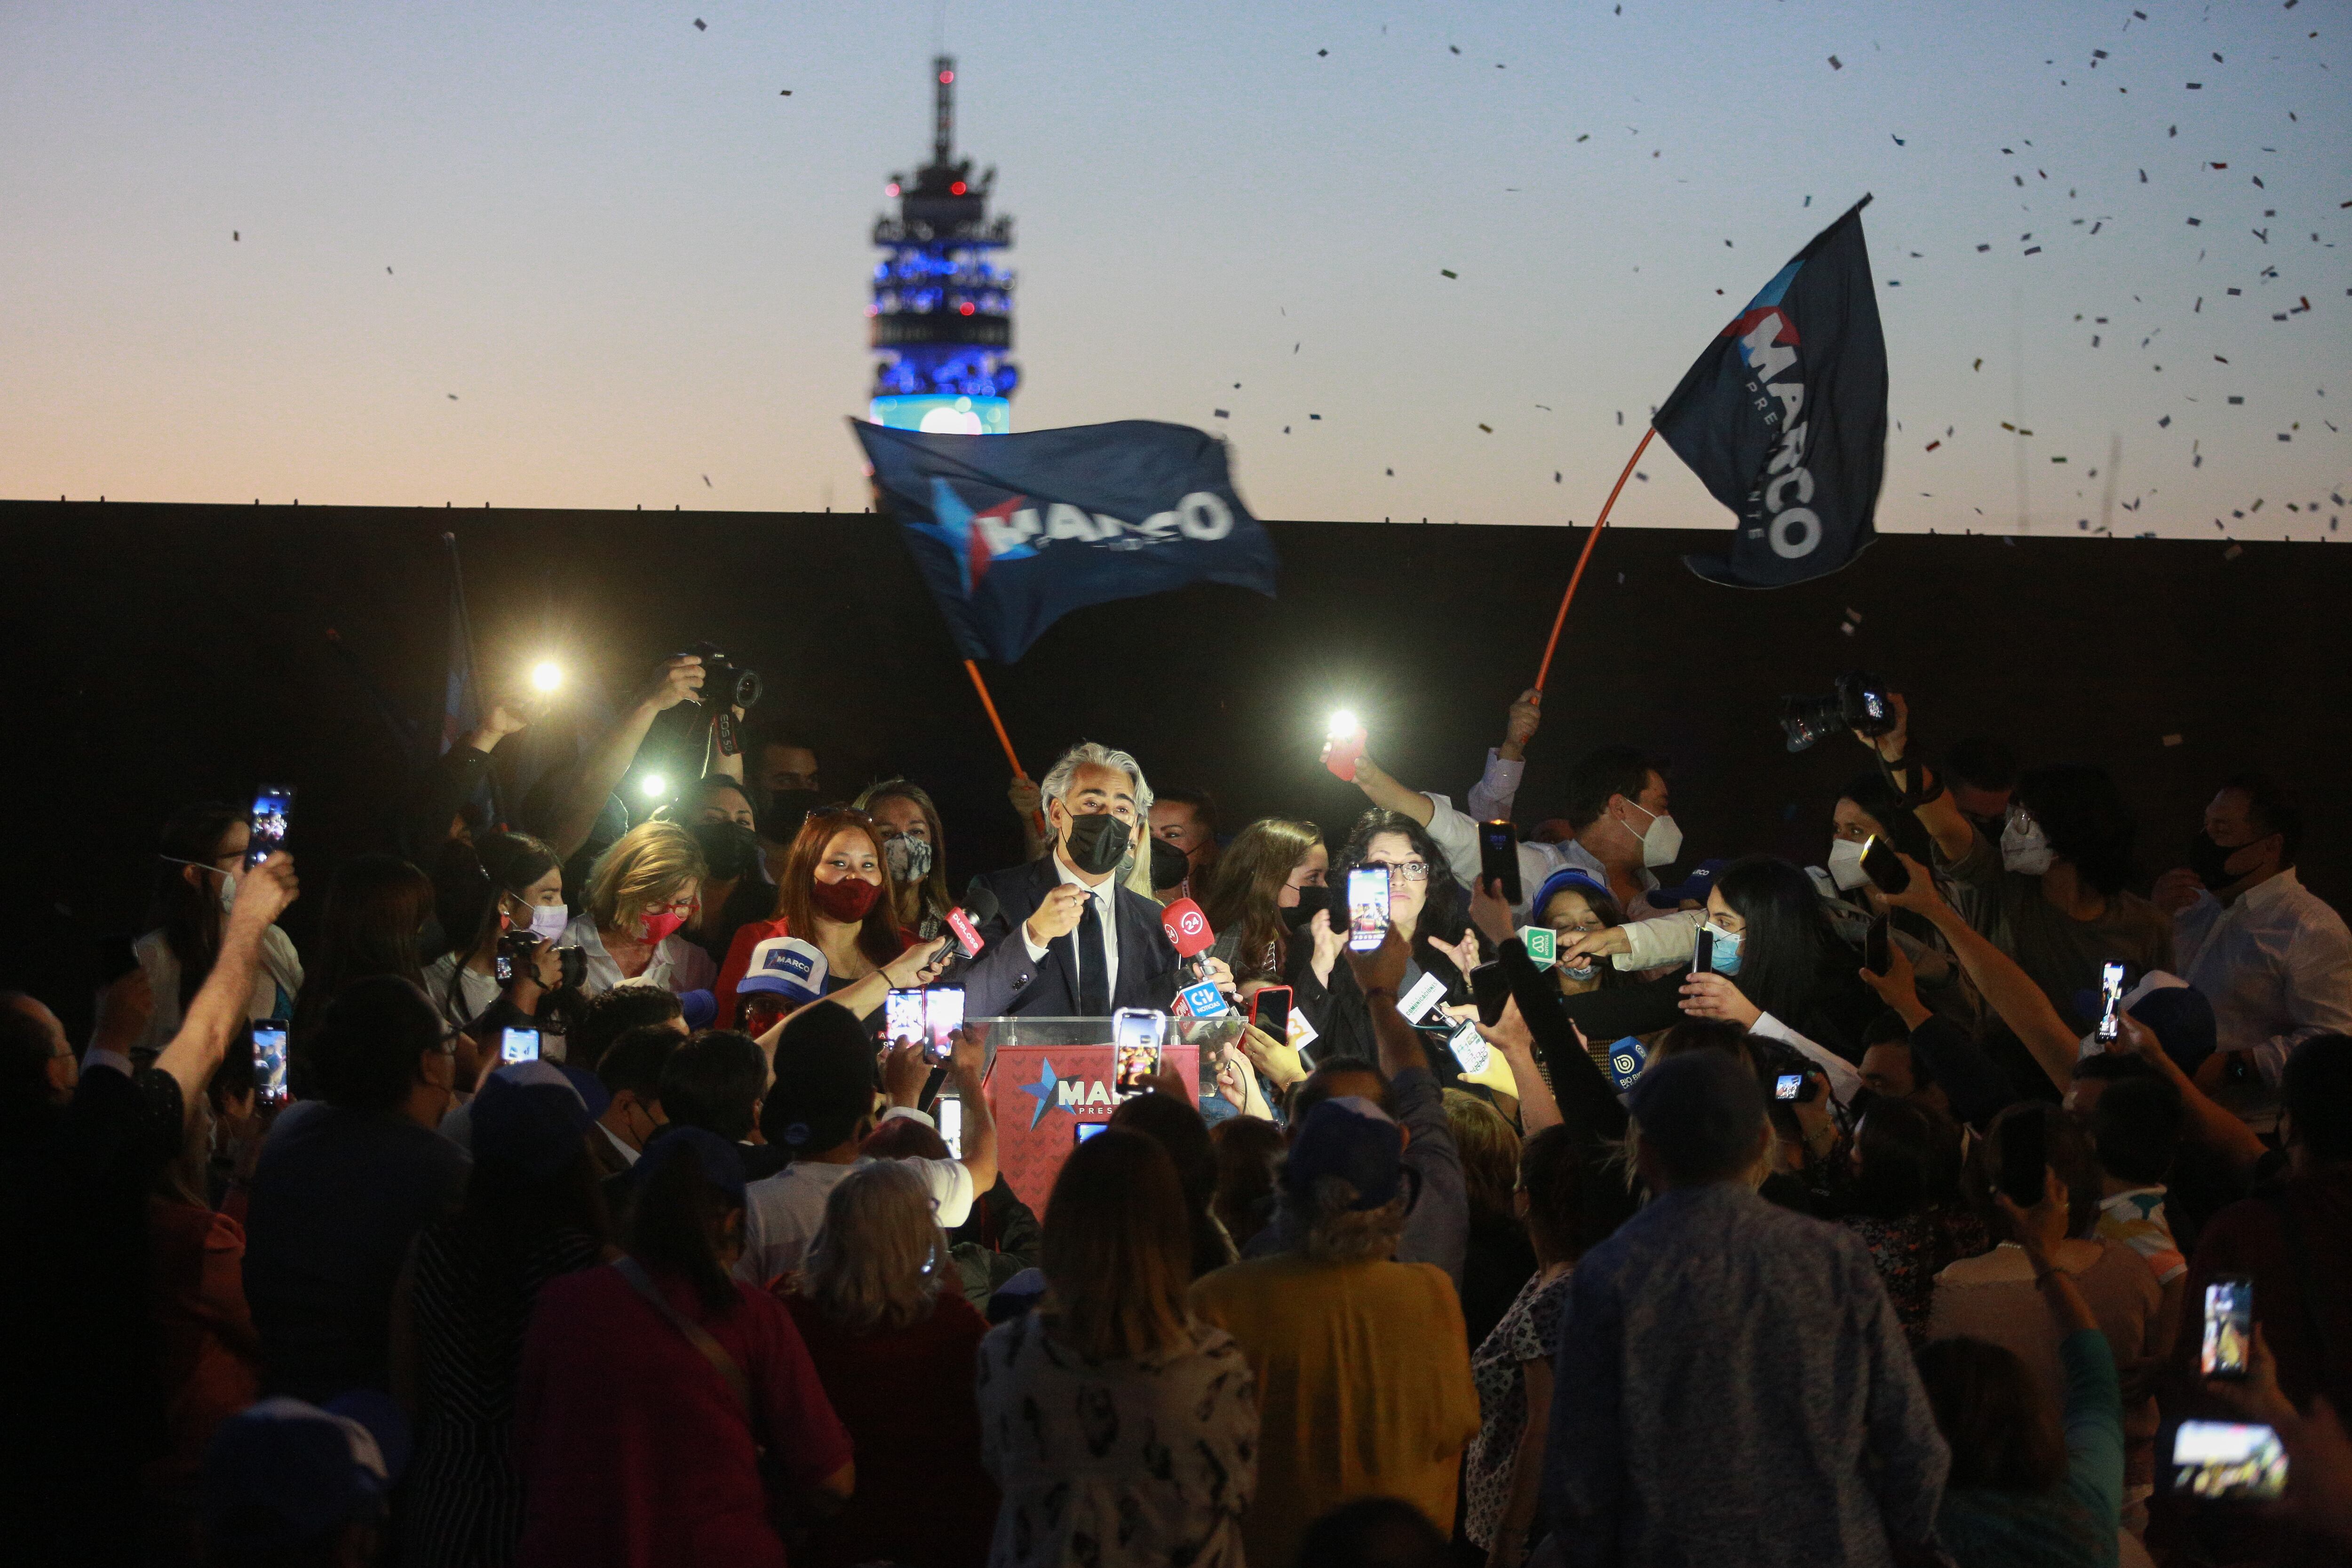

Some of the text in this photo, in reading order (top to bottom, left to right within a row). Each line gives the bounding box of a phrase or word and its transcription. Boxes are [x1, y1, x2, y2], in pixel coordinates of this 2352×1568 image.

[1742, 312, 1822, 559] MARCO
[720, 714, 730, 738] EOS
[1185, 916, 1199, 931] 24
[1167, 929, 1175, 938] 24
[777, 956, 810, 972] MARCO
[1406, 981, 1438, 1016] COMUNICACIONES
[1196, 1001, 1221, 1013] NOTICIAS
[1620, 1076, 1632, 1086] BIO
